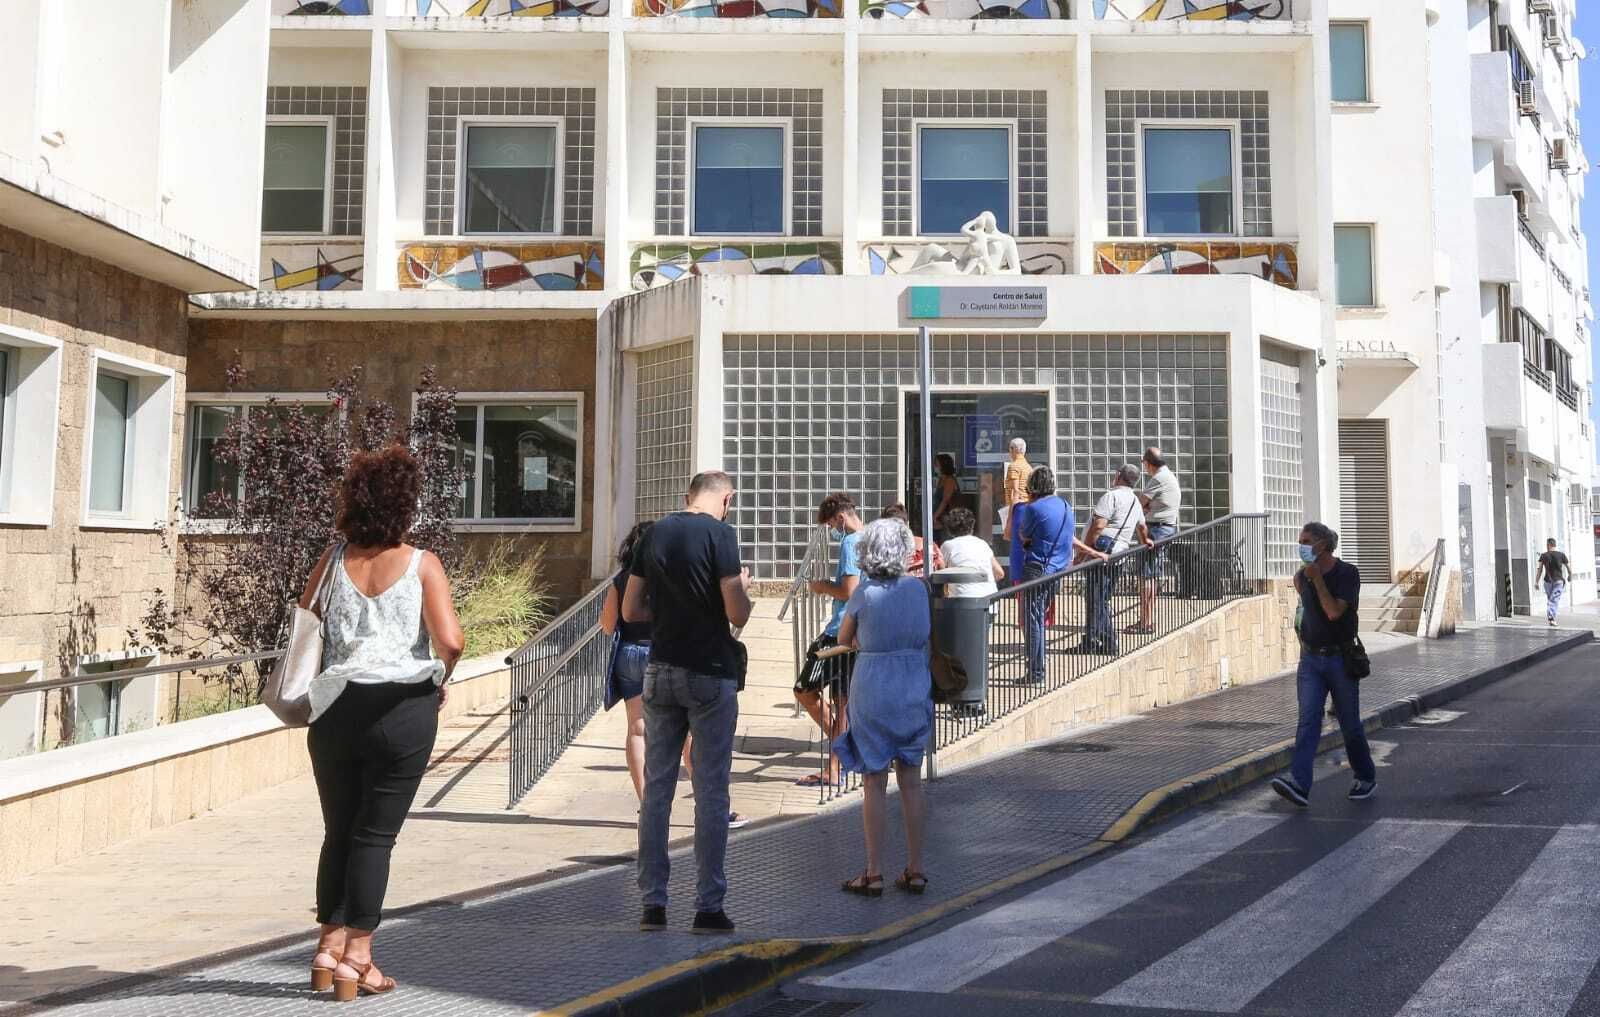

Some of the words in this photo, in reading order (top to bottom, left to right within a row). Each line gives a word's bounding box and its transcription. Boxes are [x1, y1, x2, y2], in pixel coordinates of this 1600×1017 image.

[993, 292, 1014, 300] Centro
[1015, 292, 1023, 300] de
[1024, 292, 1043, 300] Salud
